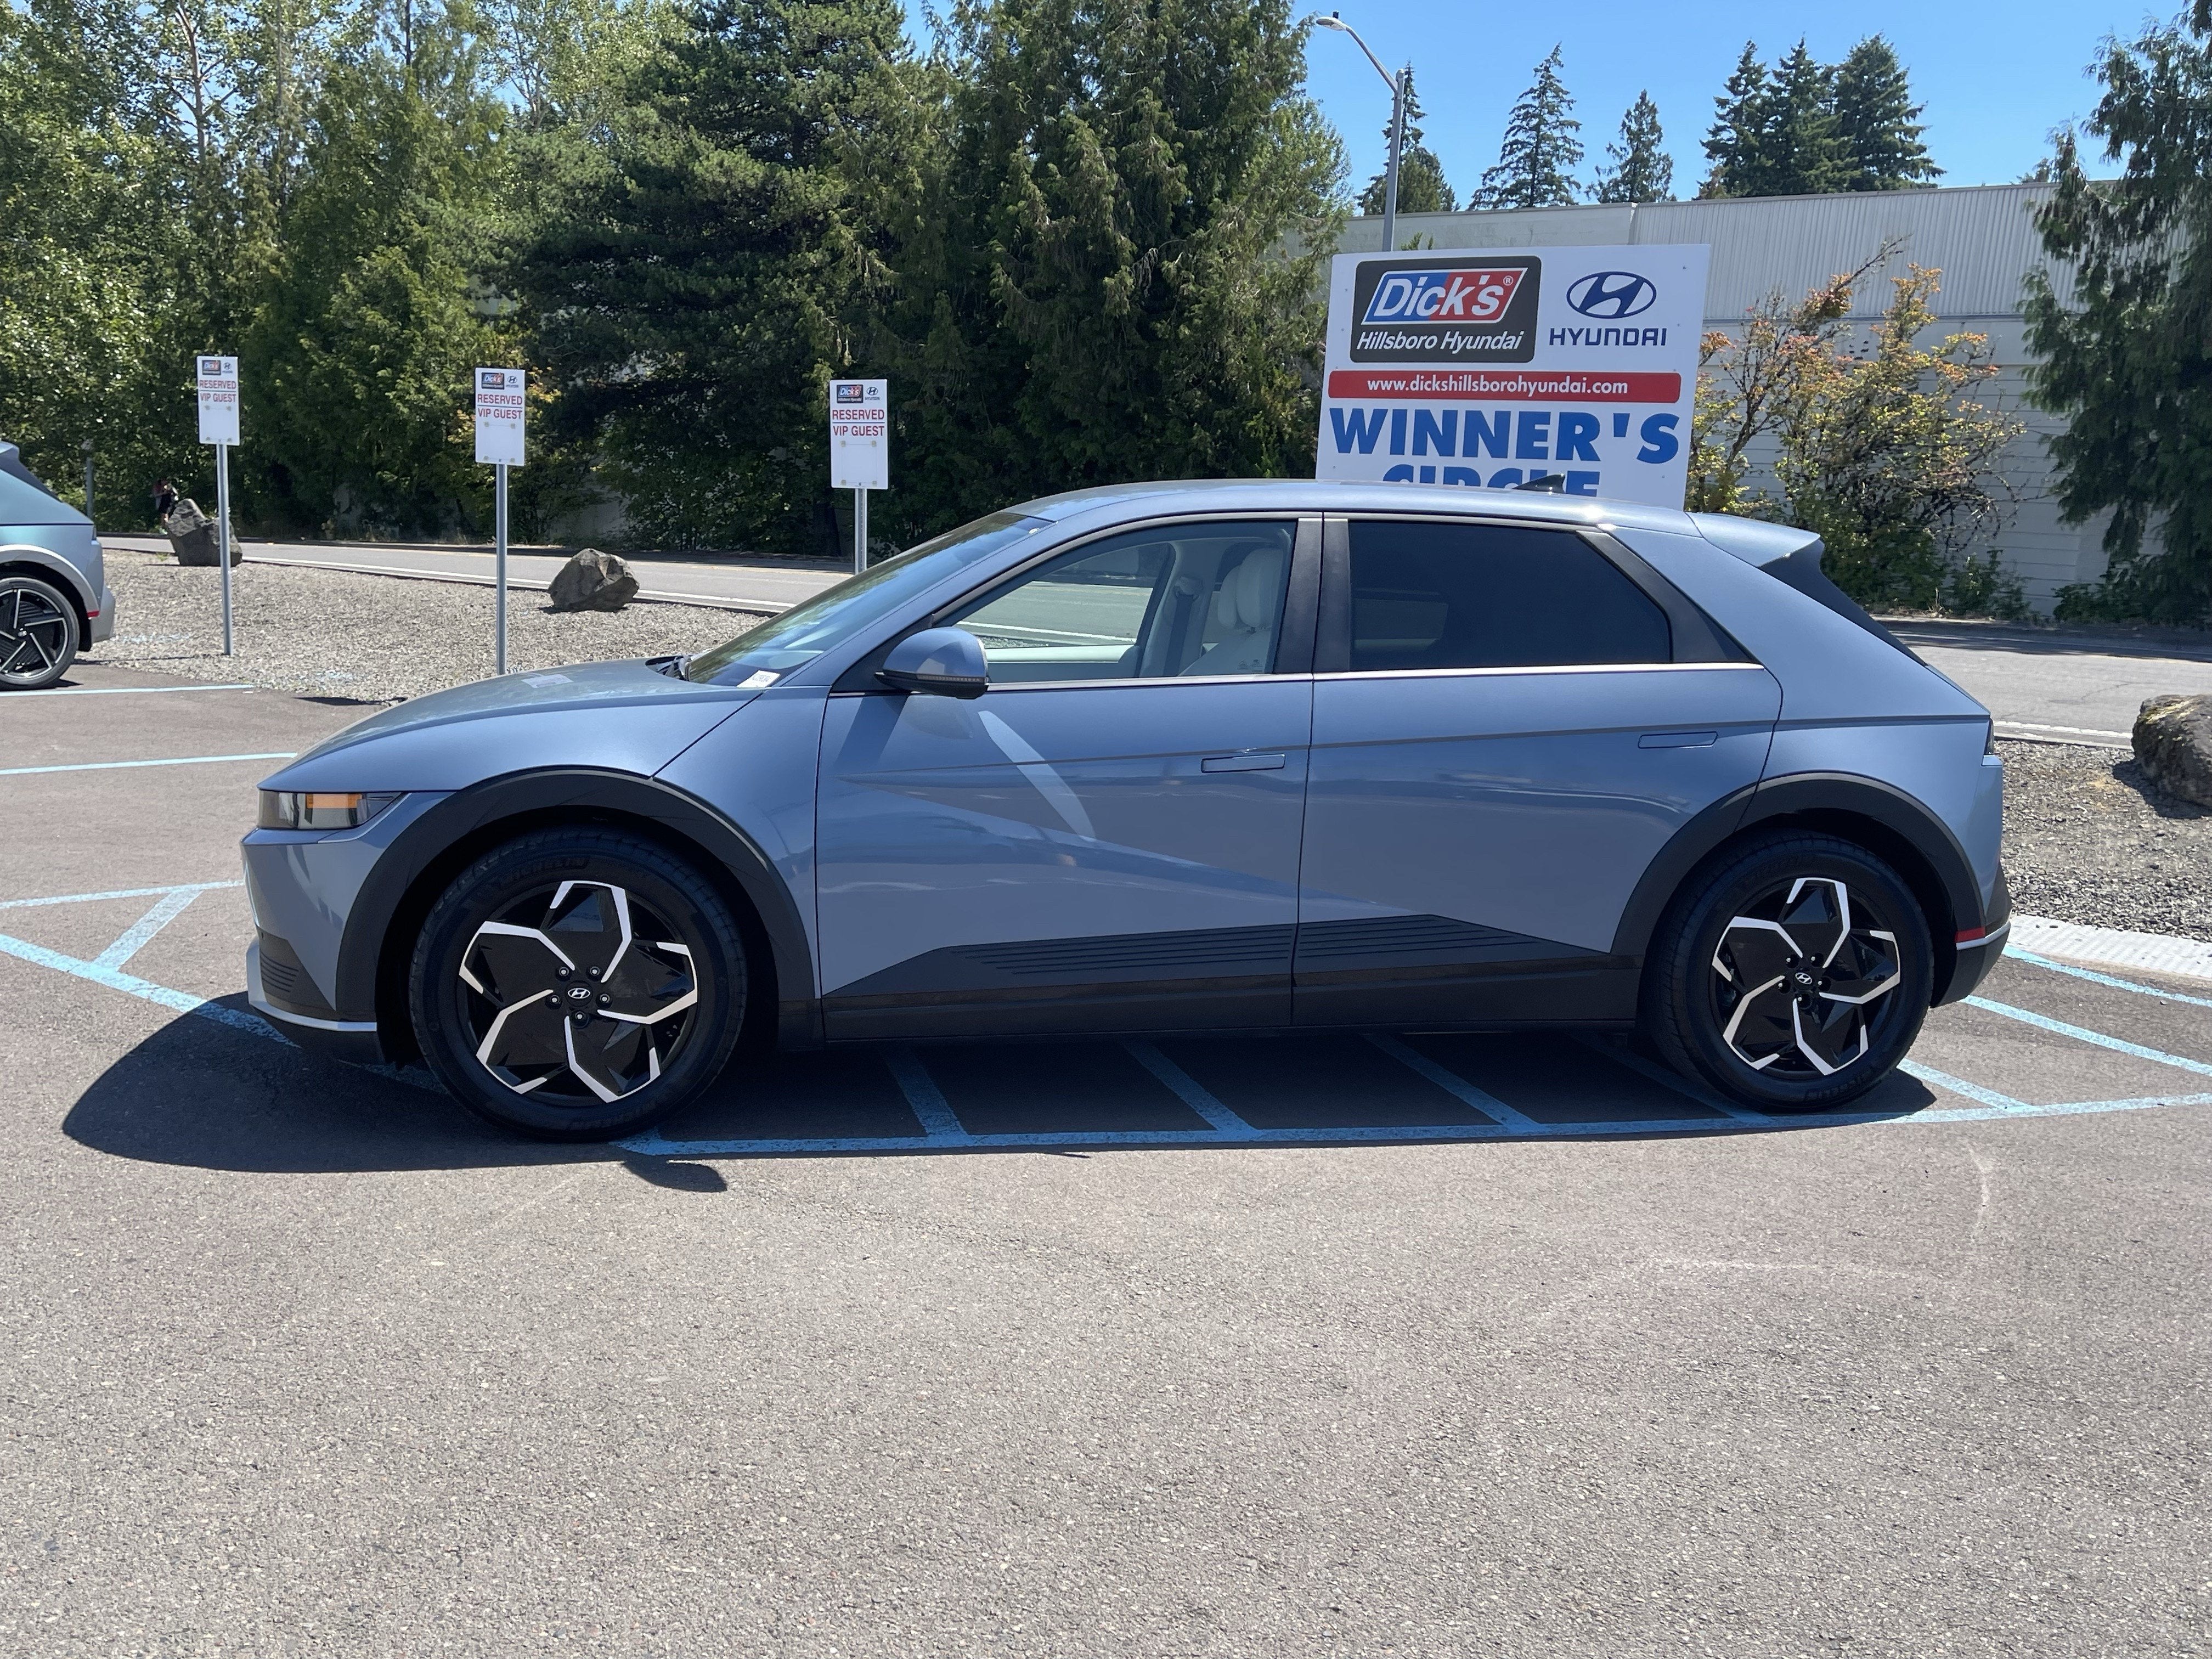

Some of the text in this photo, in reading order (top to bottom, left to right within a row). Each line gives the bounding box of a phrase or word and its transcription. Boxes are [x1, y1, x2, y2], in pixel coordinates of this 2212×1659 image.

[1356, 330, 1525, 354] Hillsboro Hyundai
[1549, 328, 1667, 347] HYUNDAI
[199, 380, 236, 389] RESERVED
[1367, 374, 1628, 397] www.dickshillsborohyundai.com
[200, 393, 236, 402] VIP GUEST
[477, 394, 522, 405] RESERVED
[478, 408, 522, 419] VIP GUEST
[832, 409, 884, 420] RESERVED
[833, 425, 884, 436] VIP GUEST
[1329, 408, 1680, 465] WINNER'S
